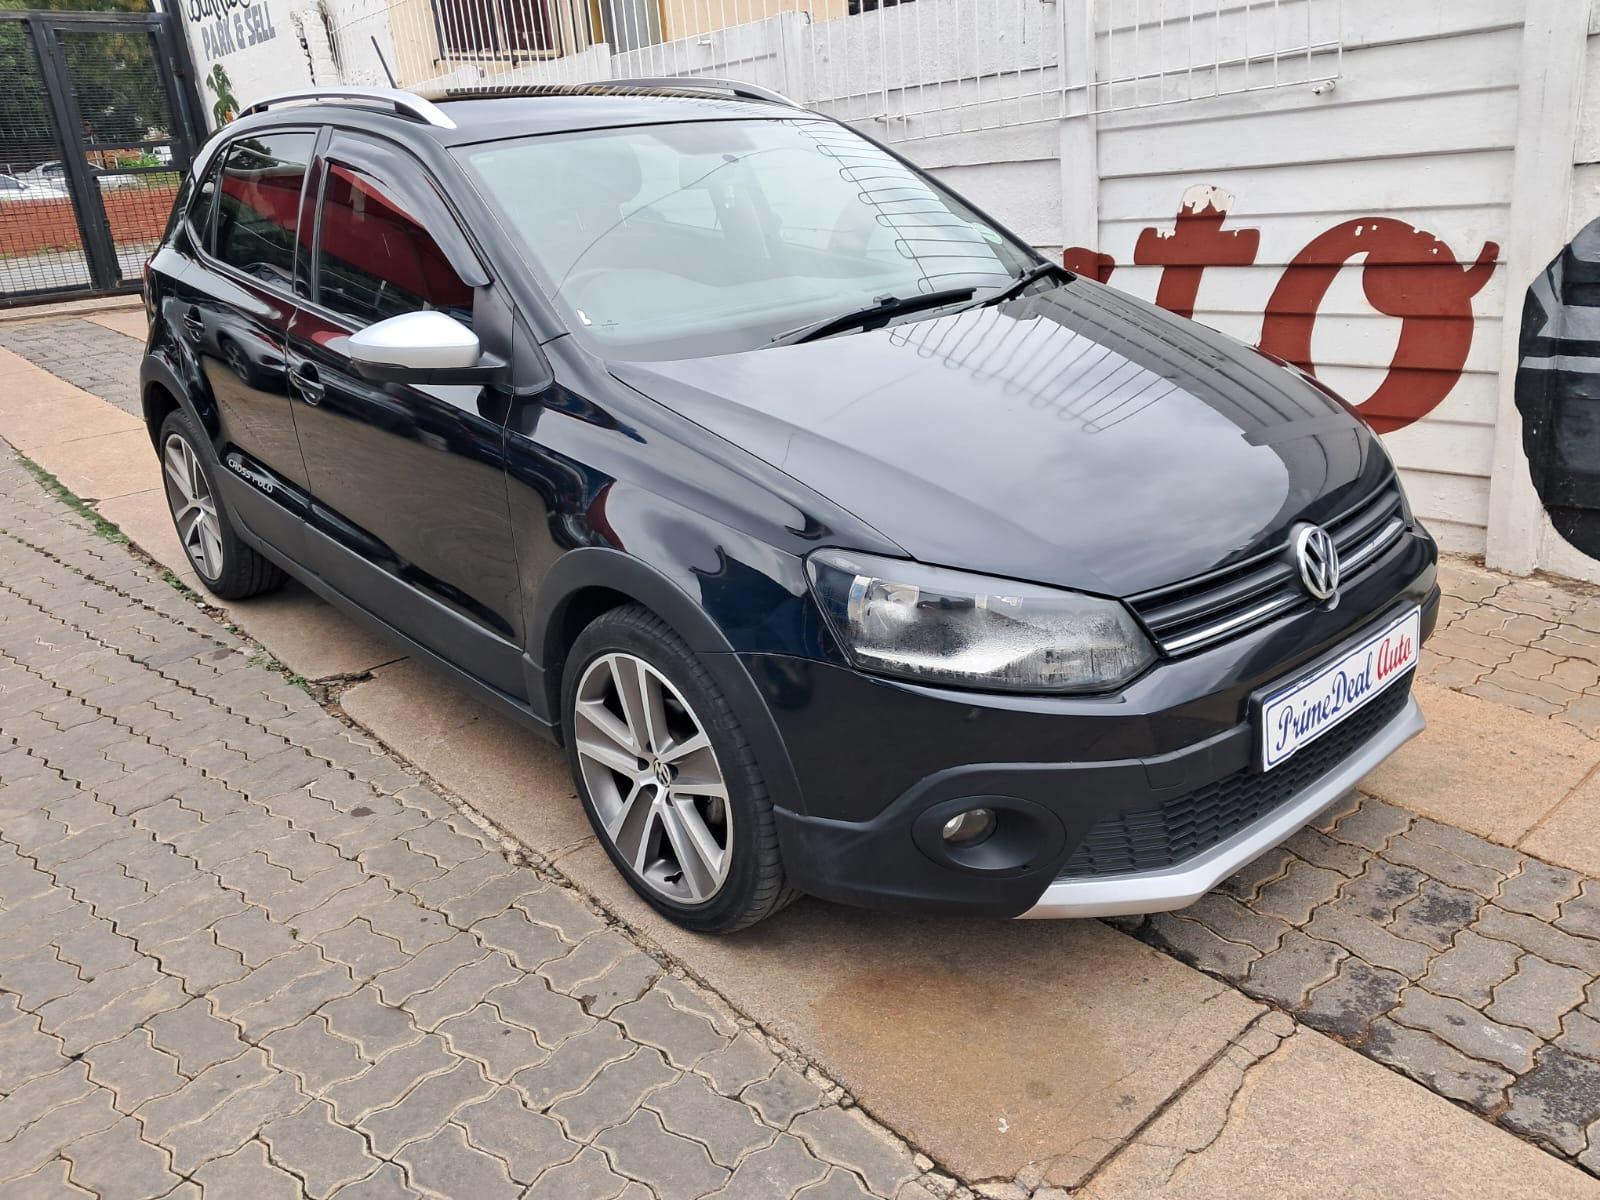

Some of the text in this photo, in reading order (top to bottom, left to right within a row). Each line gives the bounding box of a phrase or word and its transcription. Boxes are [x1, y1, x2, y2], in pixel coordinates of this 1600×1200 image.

[201, 18, 236, 61] PARK
[233, 12, 246, 50] &
[244, 0, 276, 46] SELL
[228, 459, 273, 493] CROSS POLO
[1276, 633, 1412, 751] PrimeDeal Auto
